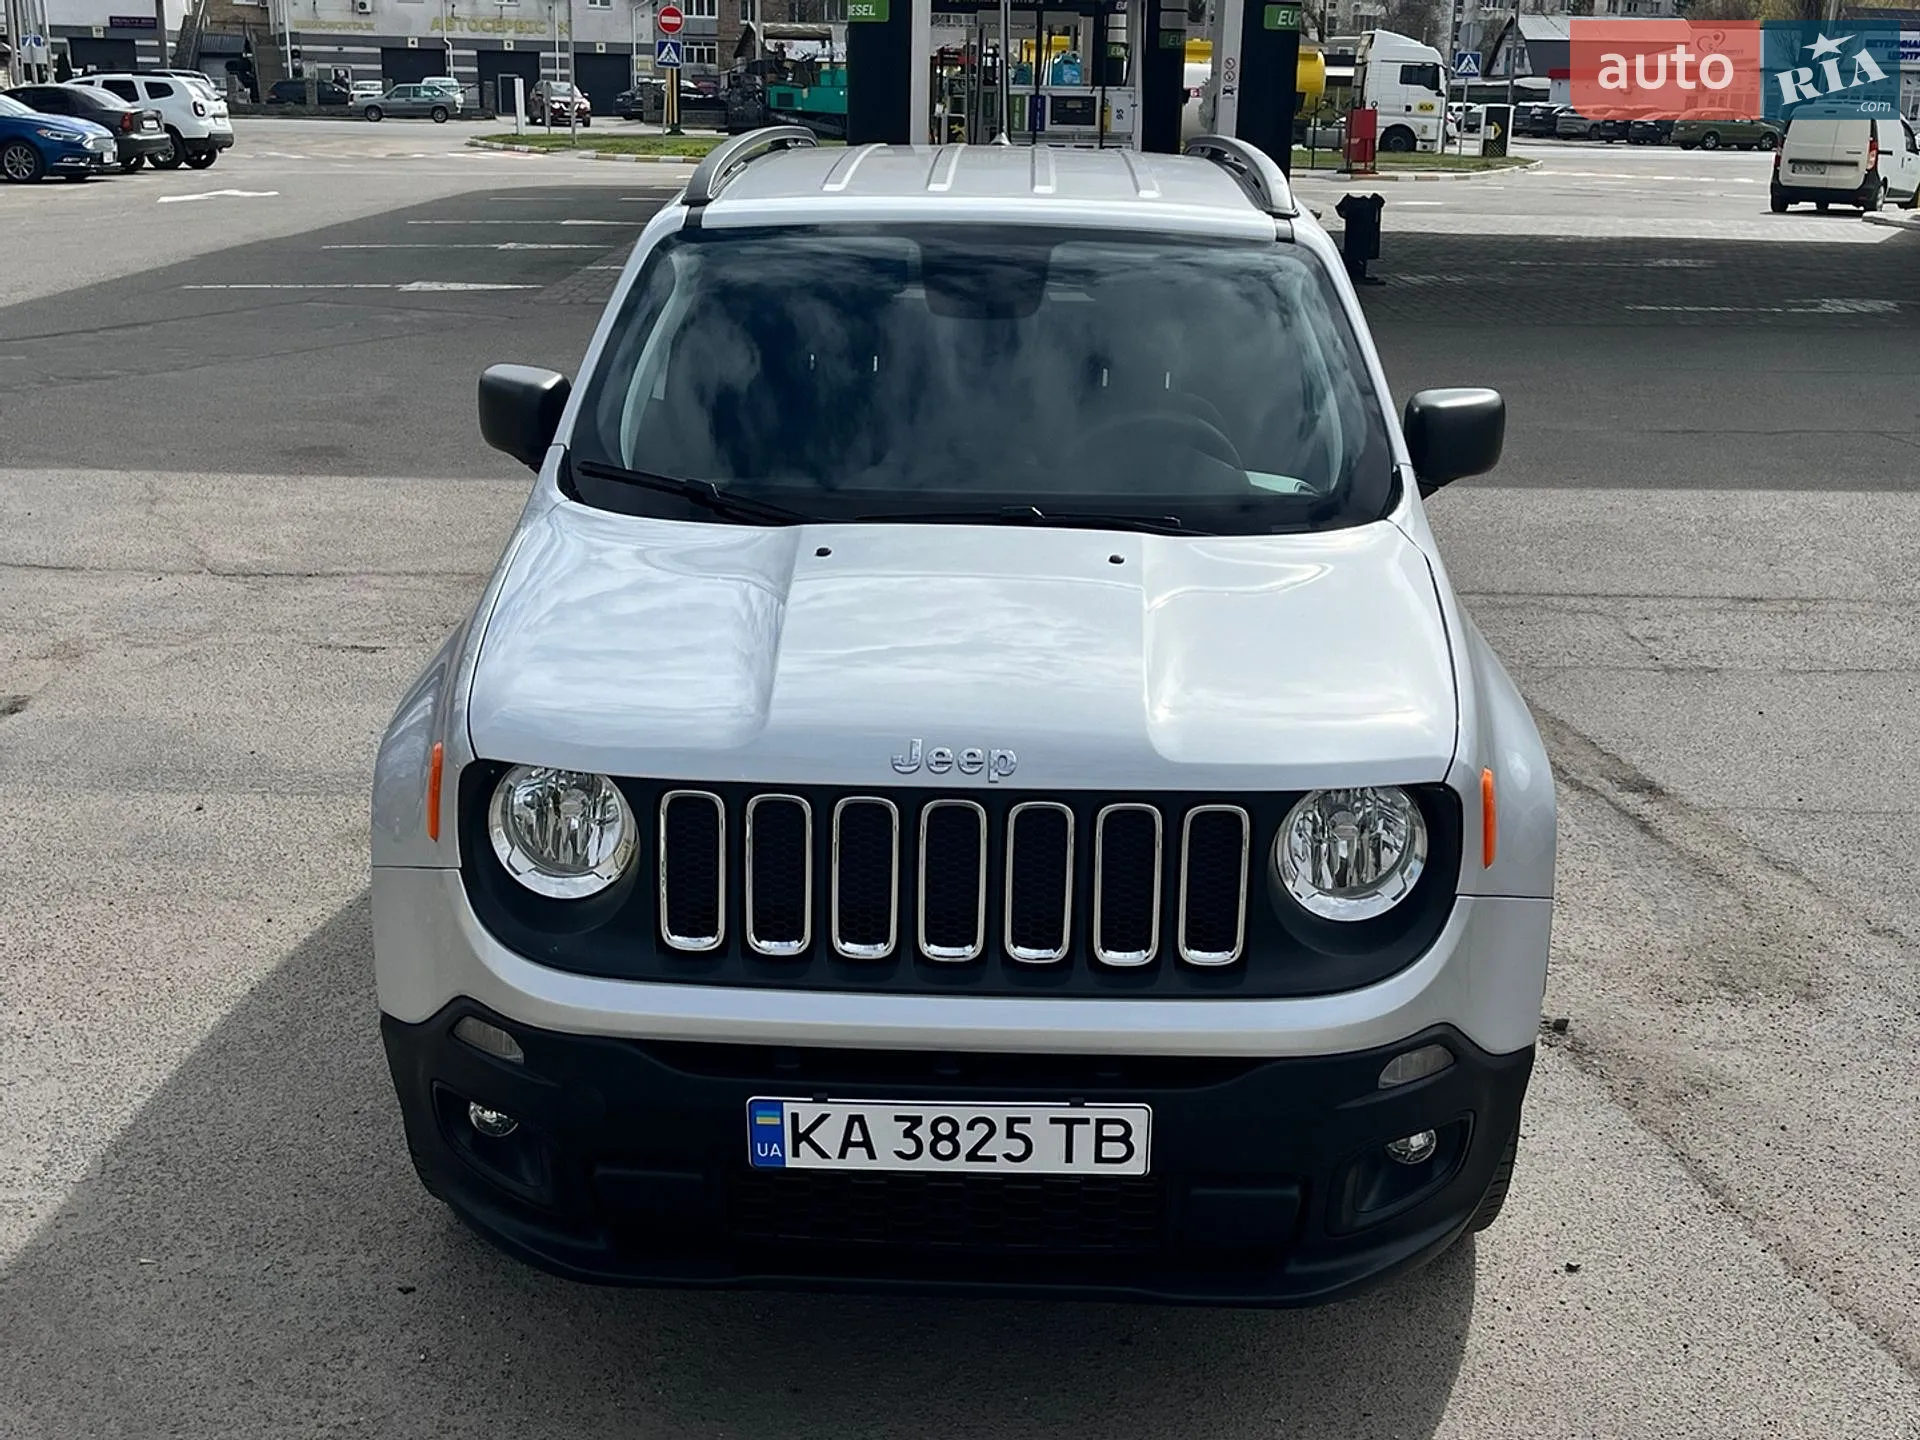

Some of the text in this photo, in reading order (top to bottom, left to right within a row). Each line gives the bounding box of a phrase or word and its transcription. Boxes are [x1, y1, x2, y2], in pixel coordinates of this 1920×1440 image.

[891, 738, 1018, 784] Jeep
[756, 1142, 783, 1158] UA
[789, 1111, 1136, 1165] KA 3825 TB
